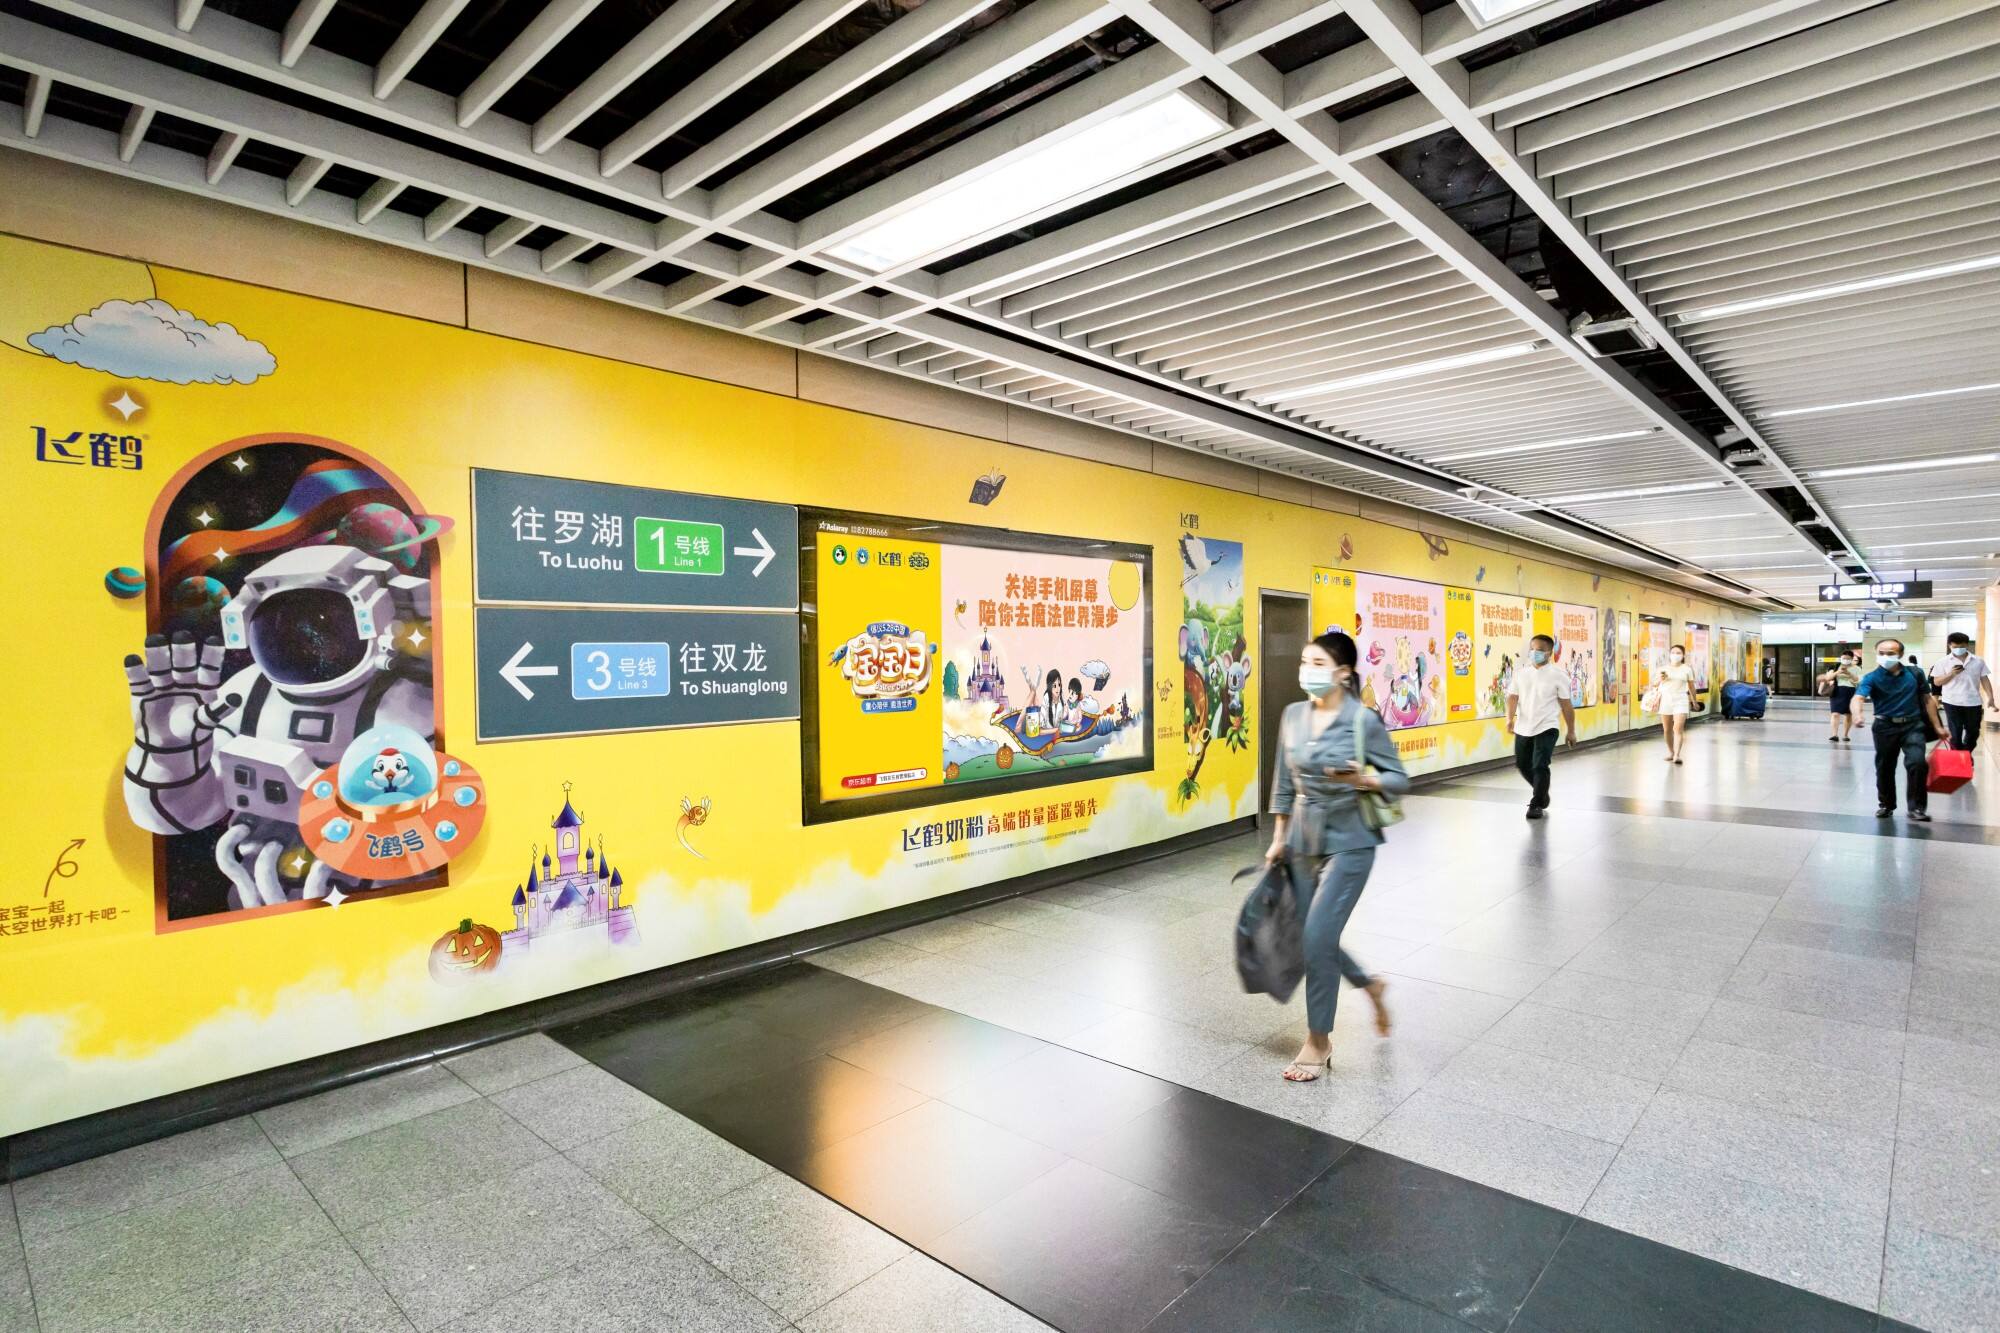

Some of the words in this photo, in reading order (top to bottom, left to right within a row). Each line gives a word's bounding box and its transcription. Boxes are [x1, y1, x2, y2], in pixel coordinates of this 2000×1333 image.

[29, 425, 143, 471] 飞鹤
[511, 504, 623, 548] 往罗湖
[538, 551, 562, 569] To
[566, 552, 623, 571] Luohu
[649, 526, 665, 566] 1
[673, 535, 711, 556] 号线
[674, 556, 694, 567] Line
[1005, 572, 1099, 602] 关掉手机屏幕
[978, 599, 1119, 628] 陪你去魔法世界漫步
[586, 650, 612, 691] 3
[617, 657, 657, 678] 号线
[679, 642, 768, 675] 往双龙
[617, 680, 640, 691] Line
[640, 680, 648, 690] 3
[679, 681, 699, 696] To
[701, 679, 788, 697] Shuanglong
[901, 815, 984, 852] 飞鹤奶粉
[987, 797, 1098, 835] 高端销量遥遥领先
[366, 828, 425, 858] 飞鹤号
